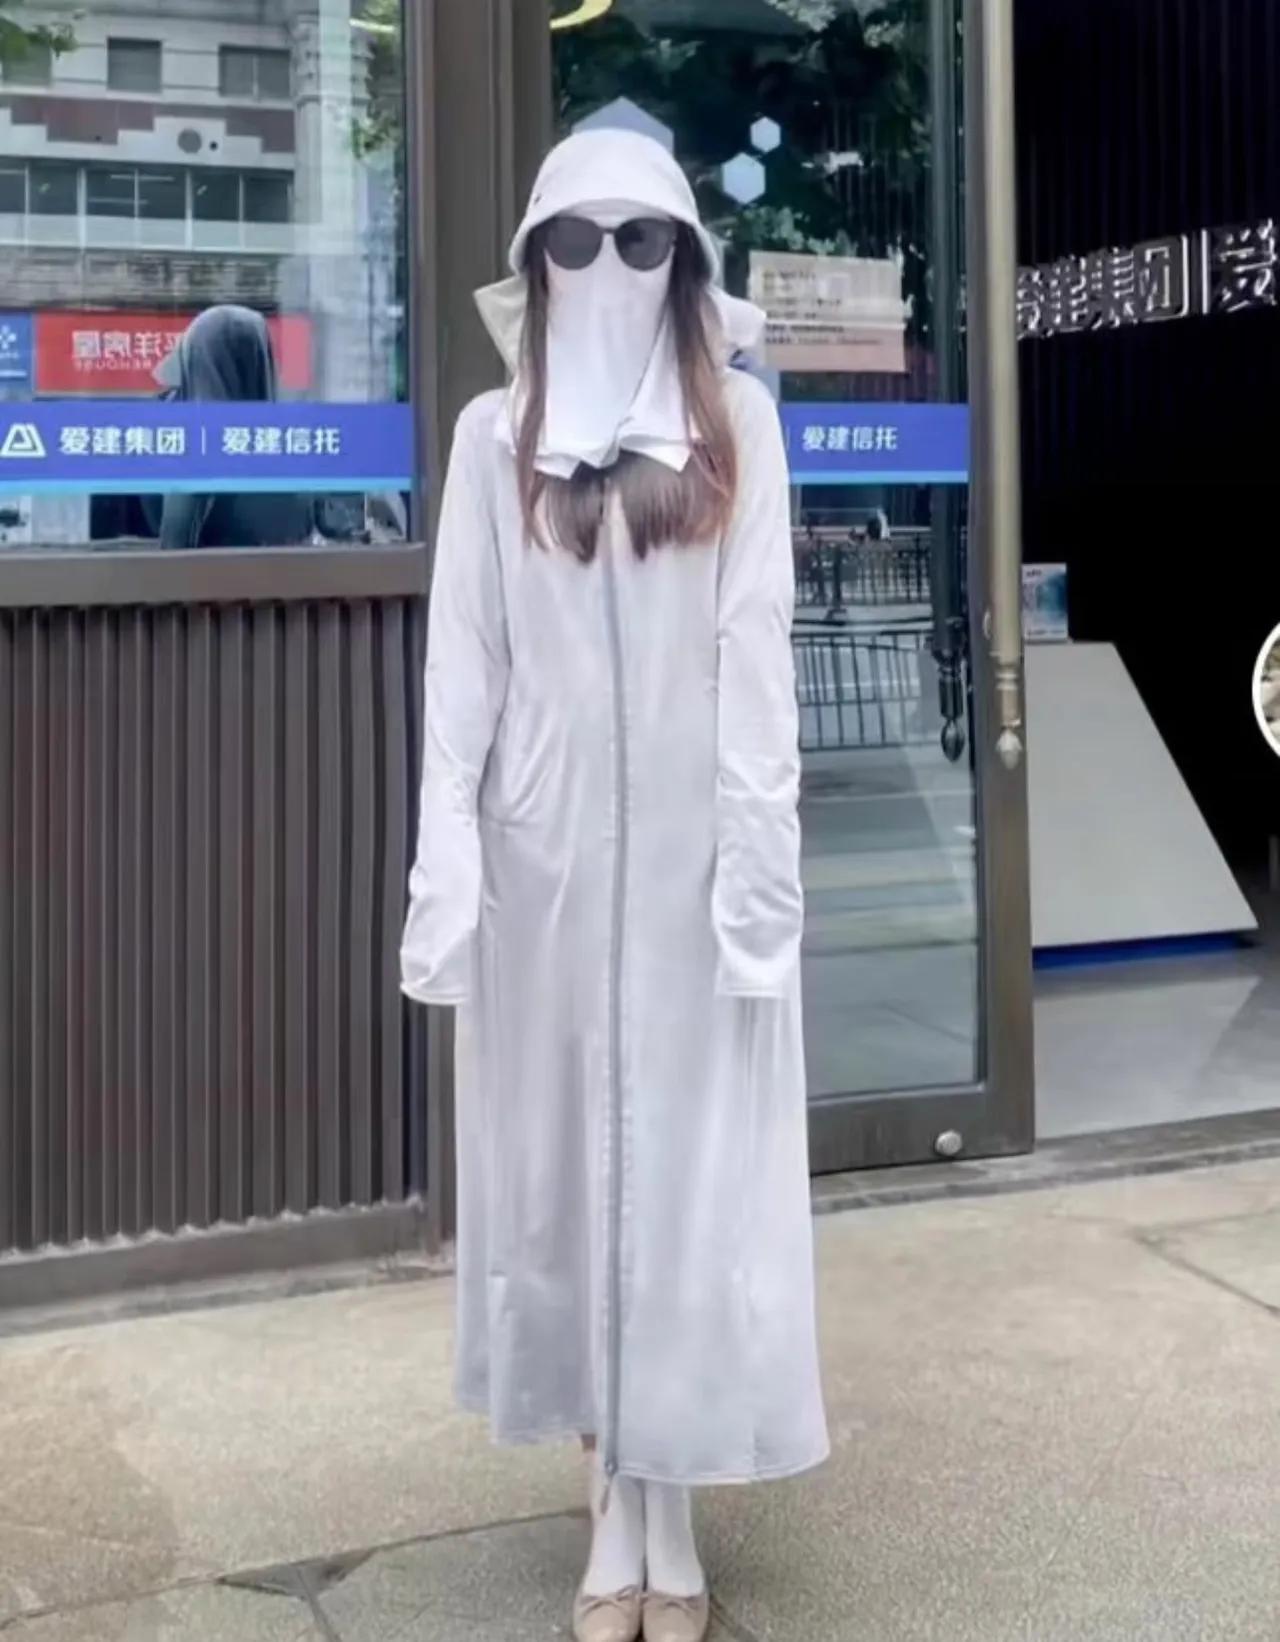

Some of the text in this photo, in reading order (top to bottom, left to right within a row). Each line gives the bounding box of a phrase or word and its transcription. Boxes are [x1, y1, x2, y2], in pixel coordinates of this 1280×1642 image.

[60, 426, 340, 455] 爱建集团 爱建信托
[803, 426, 896, 450] 爱建信托
